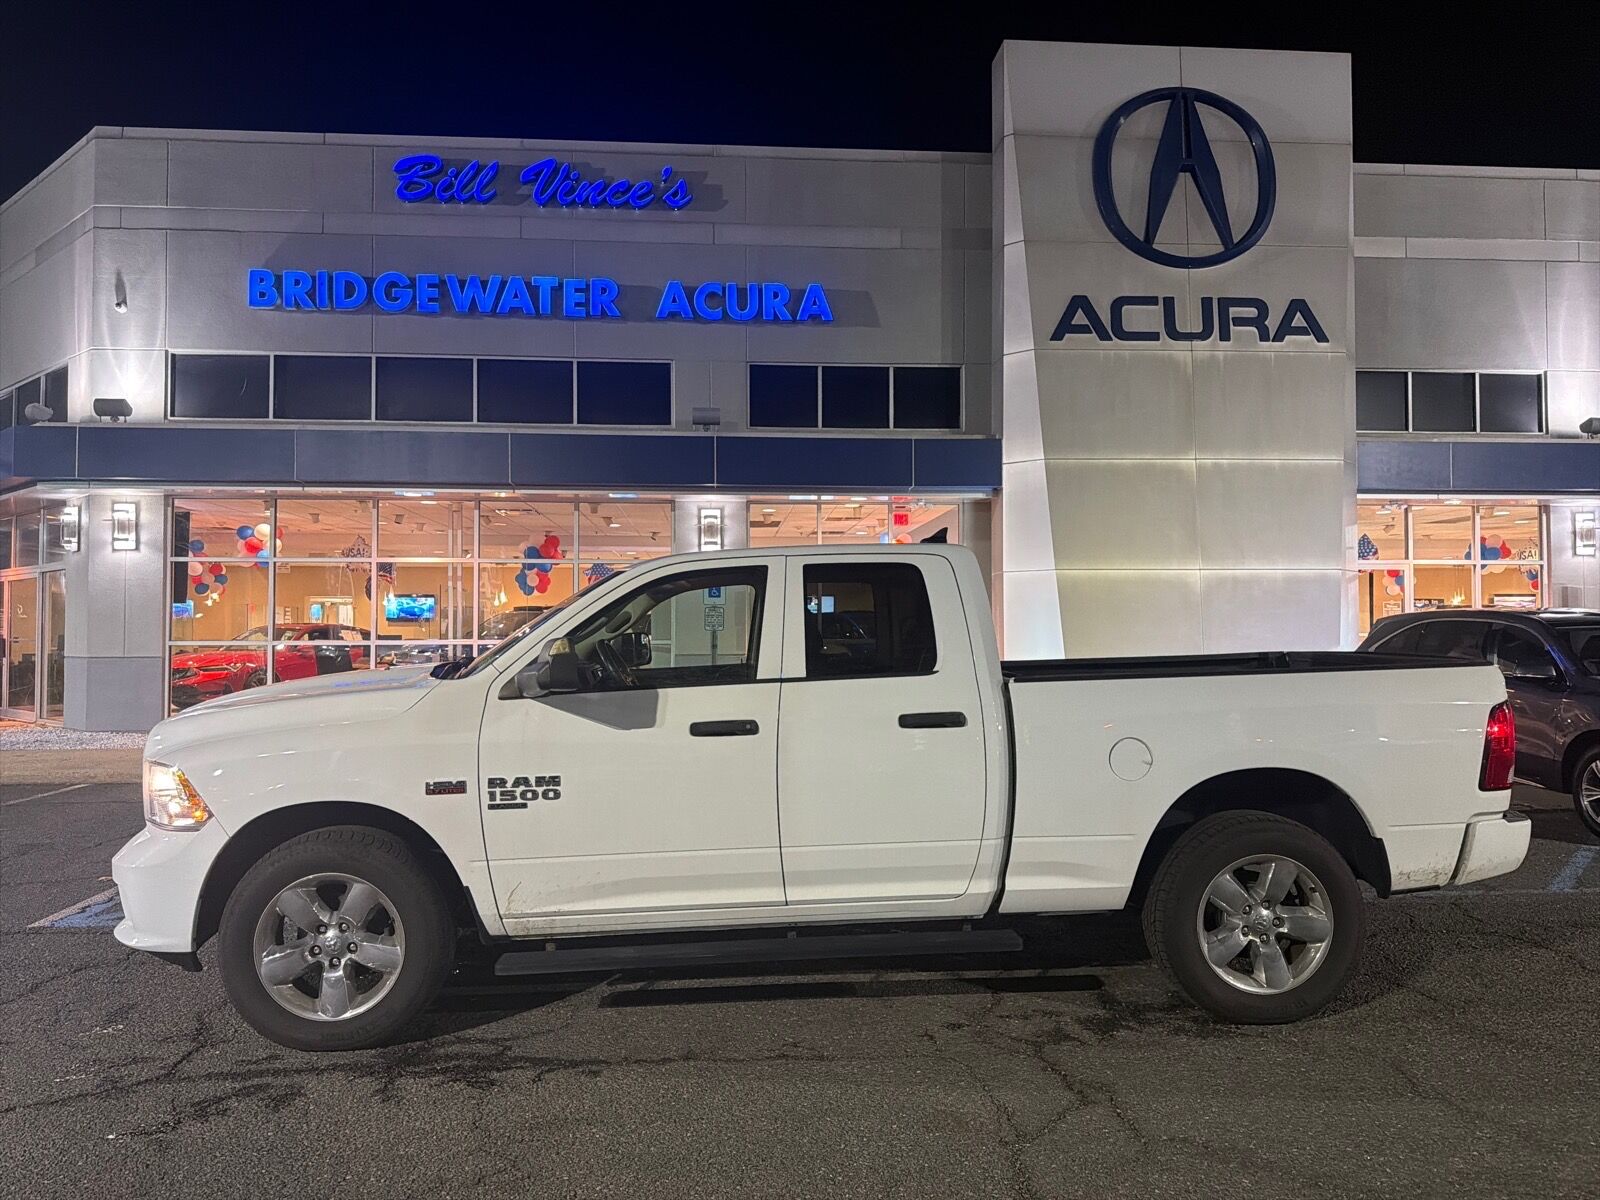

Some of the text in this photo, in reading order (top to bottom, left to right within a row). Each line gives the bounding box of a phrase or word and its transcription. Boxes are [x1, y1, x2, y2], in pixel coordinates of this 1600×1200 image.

[392, 154, 693, 210] Bill Vince's
[248, 268, 834, 323] BRIDGEWATER ACURA
[1050, 295, 1330, 343] ACURA
[488, 775, 561, 789] RAM
[488, 788, 561, 802] 1500
